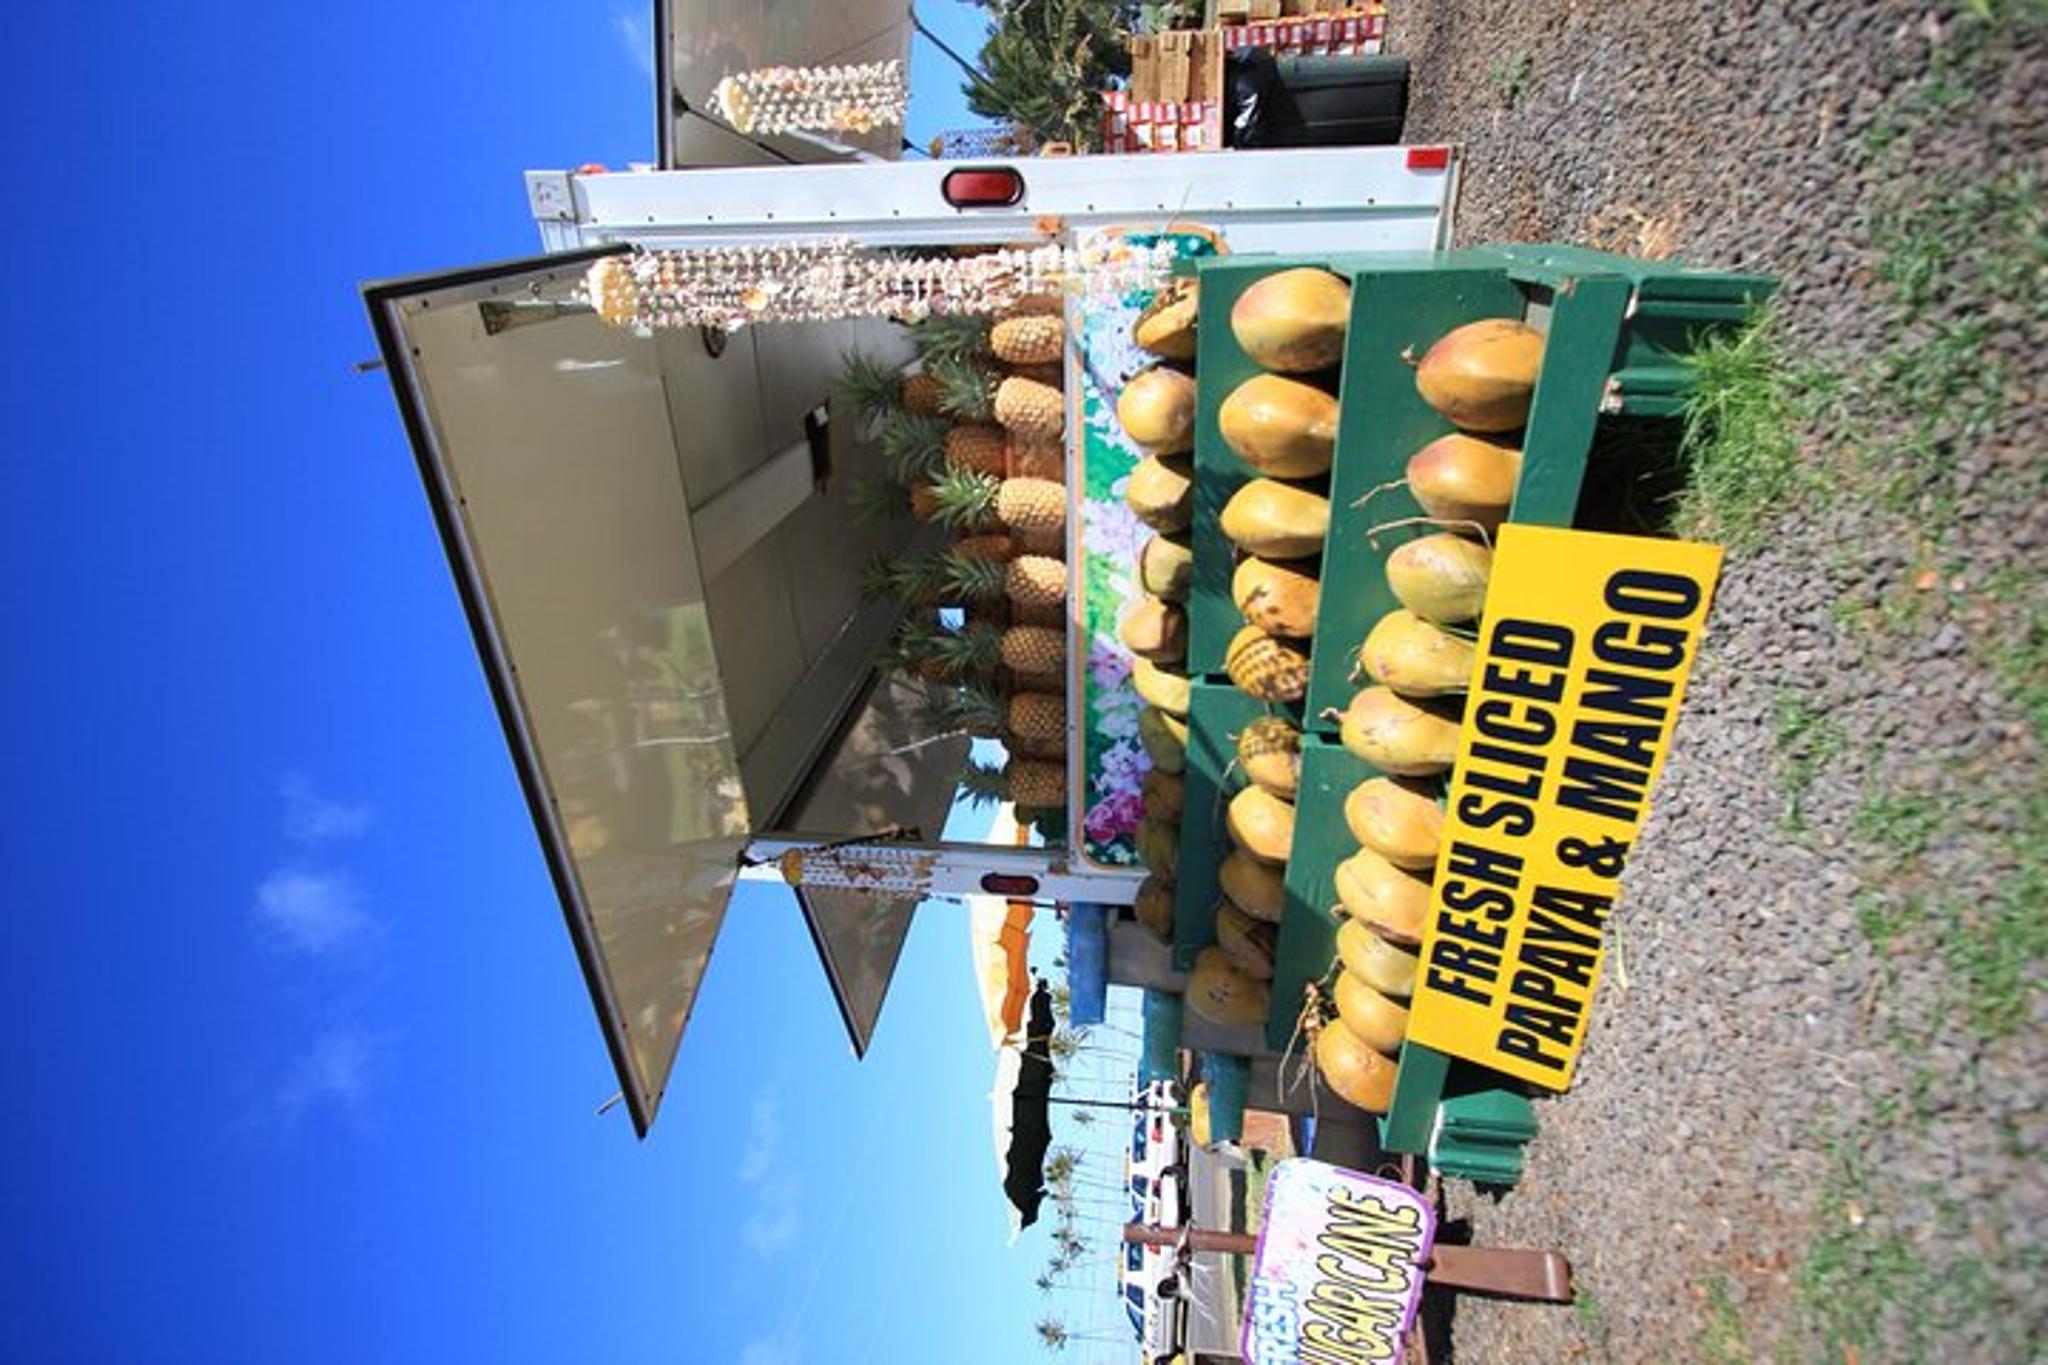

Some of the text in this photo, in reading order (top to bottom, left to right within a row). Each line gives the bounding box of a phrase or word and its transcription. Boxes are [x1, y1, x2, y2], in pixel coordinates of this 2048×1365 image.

[1427, 618, 1575, 1007] FRESH SLICED
[1497, 569, 1702, 1071] PAPAYA & MANGO
